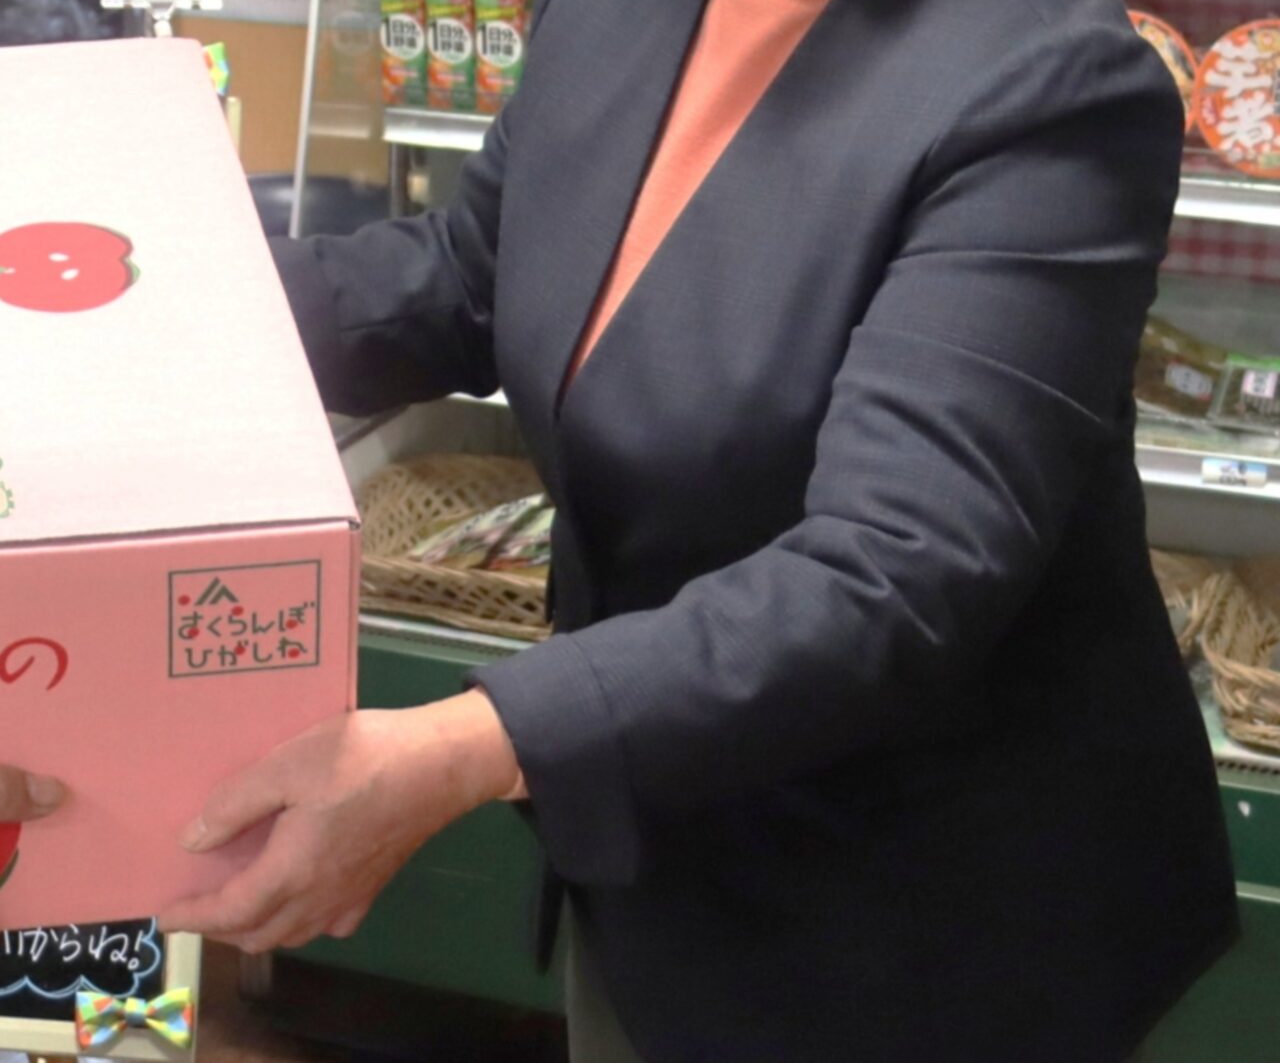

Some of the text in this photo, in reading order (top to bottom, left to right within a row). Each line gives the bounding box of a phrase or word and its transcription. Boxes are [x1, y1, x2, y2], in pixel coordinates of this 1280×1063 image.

[177, 600, 316, 640] さくらんぼ
[184, 637, 308, 669] ひがしね
